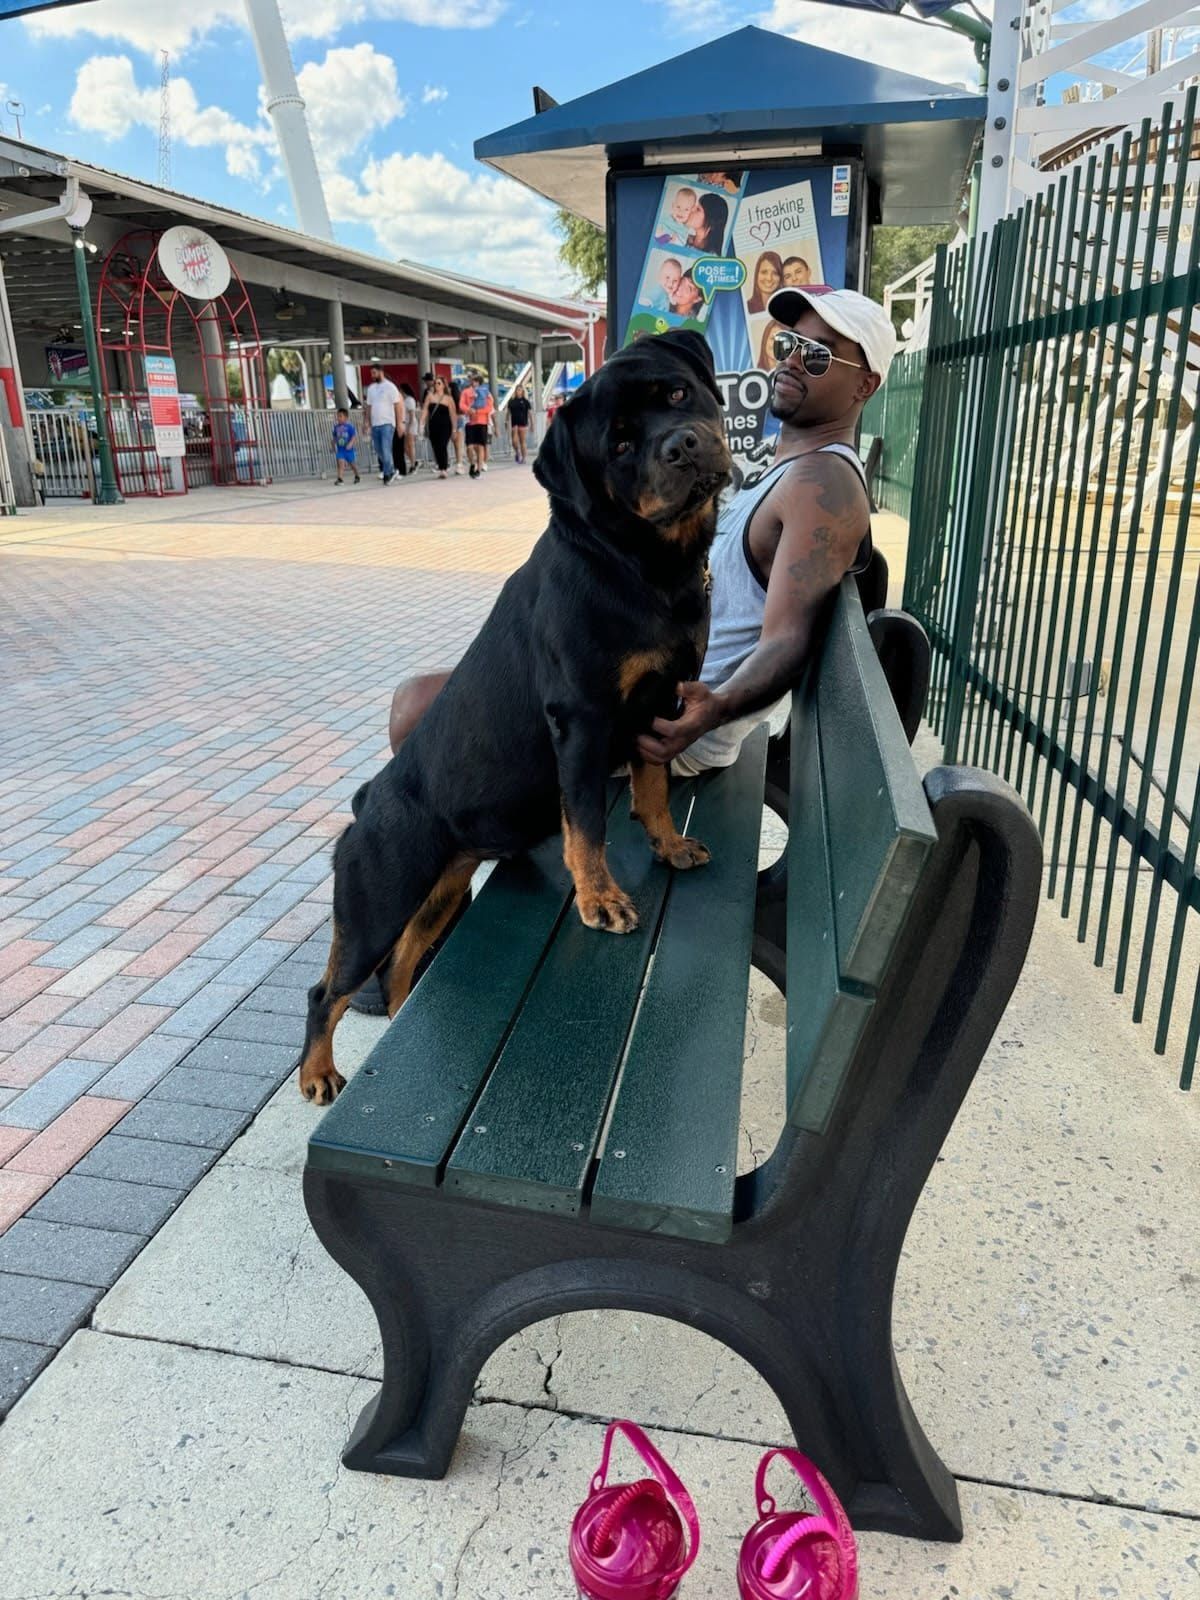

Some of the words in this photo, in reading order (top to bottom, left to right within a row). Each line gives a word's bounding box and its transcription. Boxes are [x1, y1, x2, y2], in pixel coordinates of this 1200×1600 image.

[755, 198, 805, 221] freaking
[773, 215, 800, 238] you
[698, 265, 726, 276] POSE
[716, 375, 775, 412] TO
